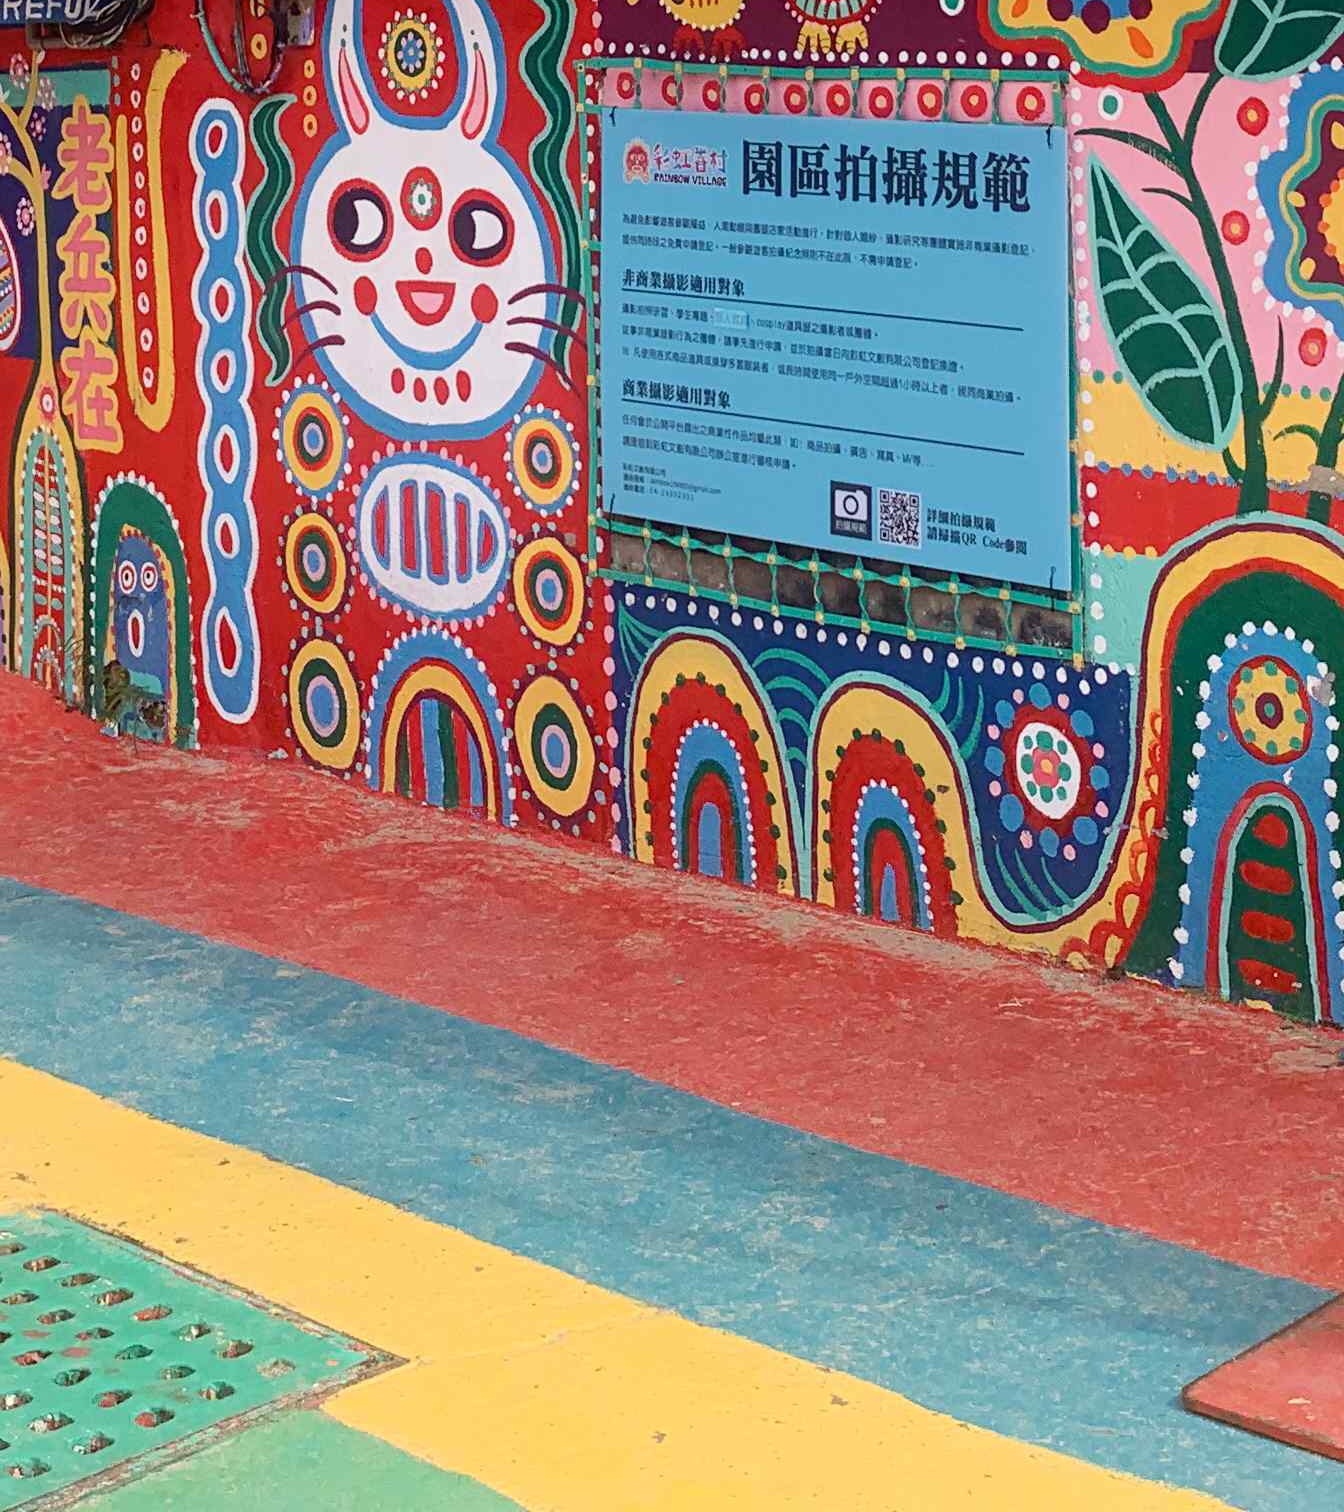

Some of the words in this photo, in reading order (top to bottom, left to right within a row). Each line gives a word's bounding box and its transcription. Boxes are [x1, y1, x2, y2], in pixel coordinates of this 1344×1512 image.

[654, 173, 690, 185] RAINBOW
[692, 175, 727, 187] VILLAGE
[742, 139, 1031, 213] 園區拍攝規範
[54, 99, 122, 450] 老兵在
[622, 269, 745, 297] 非商業攝影適用對象
[622, 378, 731, 409] 商業攝影適用對象
